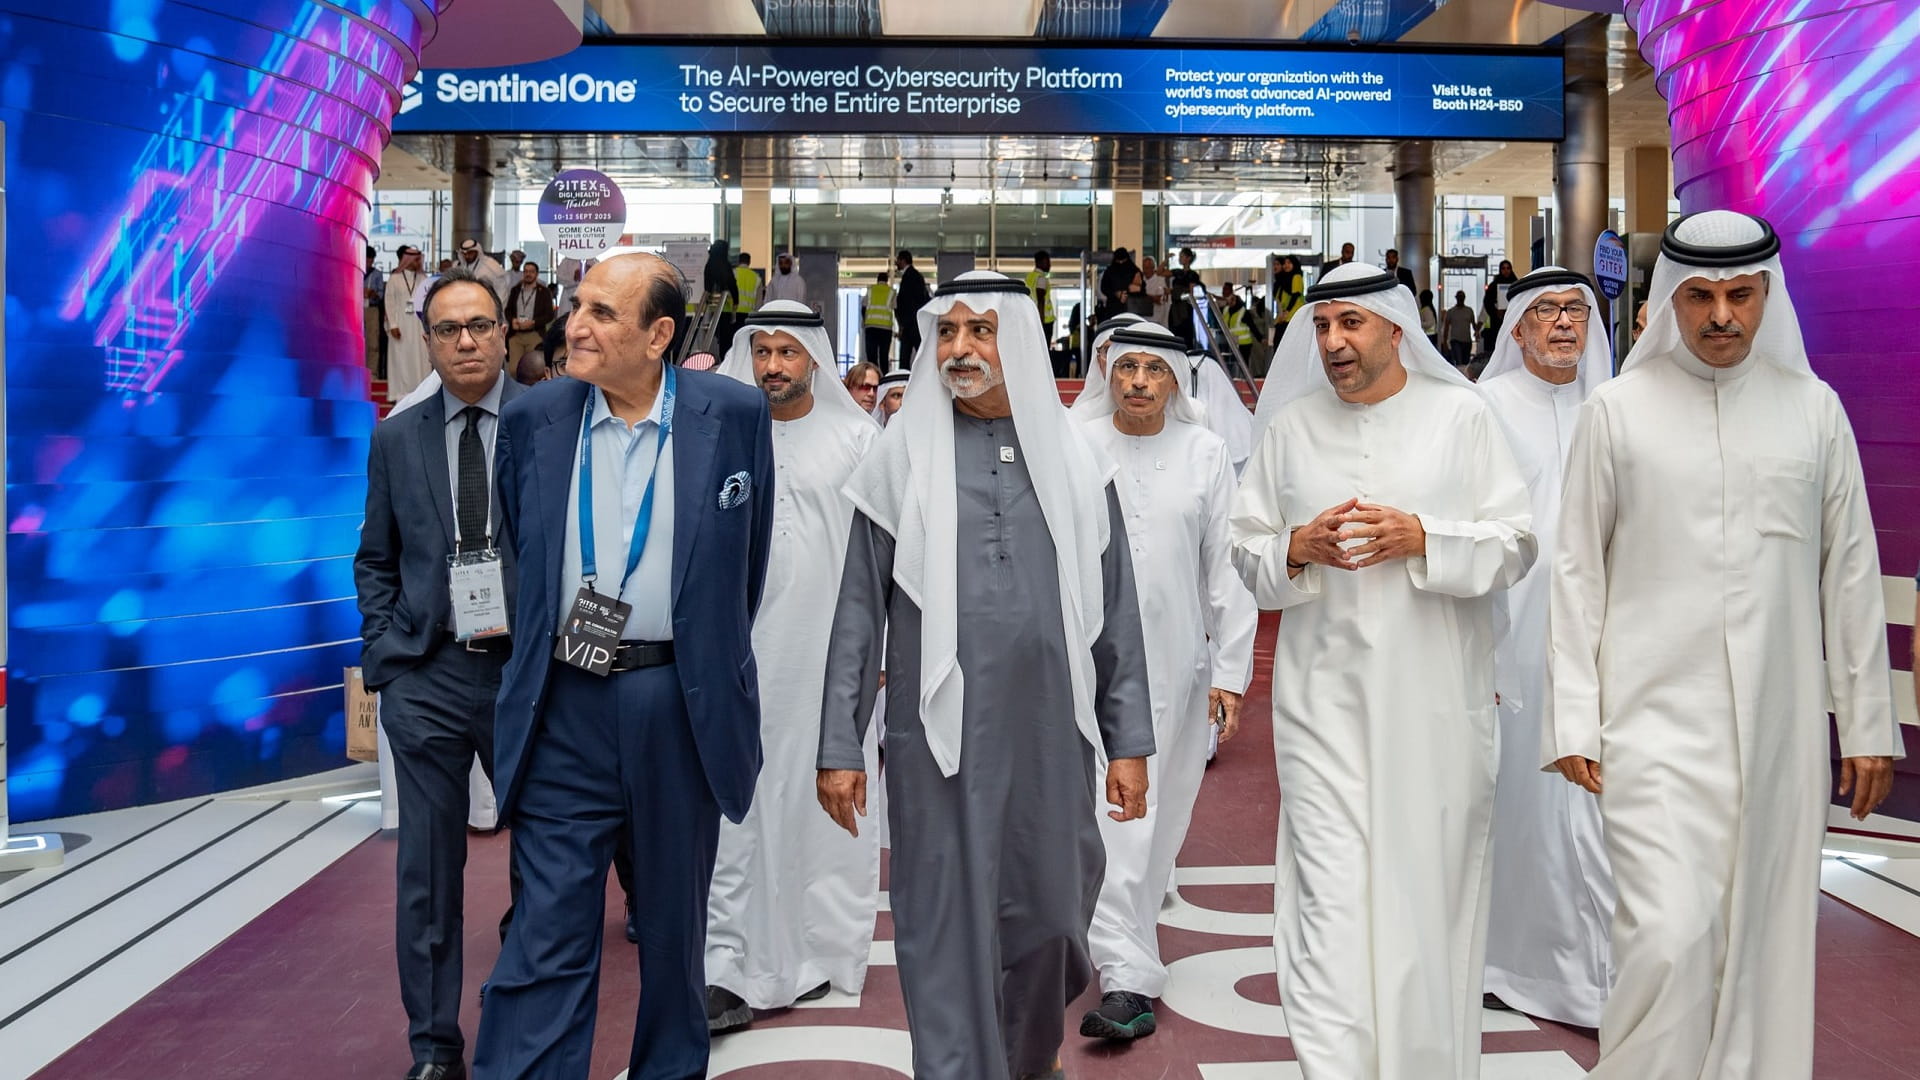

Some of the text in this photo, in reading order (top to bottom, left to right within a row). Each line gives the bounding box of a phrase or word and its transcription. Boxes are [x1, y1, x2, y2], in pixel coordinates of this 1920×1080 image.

[679, 65, 1123, 93] The AI-Powered Cybersecurity Platform
[1165, 68, 1384, 86] Protect your organization with the
[436, 73, 637, 103] SentinelOne
[1165, 86, 1392, 103] world's most advanced AI-powered
[1432, 84, 1493, 97] Visit Us at
[678, 91, 1021, 119] to Secure the Entire Enterprise
[1165, 103, 1315, 119] cybersecurity platform.
[1432, 98, 1523, 112] Booth H24-B50
[555, 180, 597, 191] GITEX
[553, 213, 574, 221] 10-12
[558, 239, 606, 250] HALL 6
[1599, 245, 1623, 257] FIND YOUR
[1599, 259, 1623, 276] GITEX
[565, 635, 610, 670] VIP
[359, 714, 371, 728] AN
